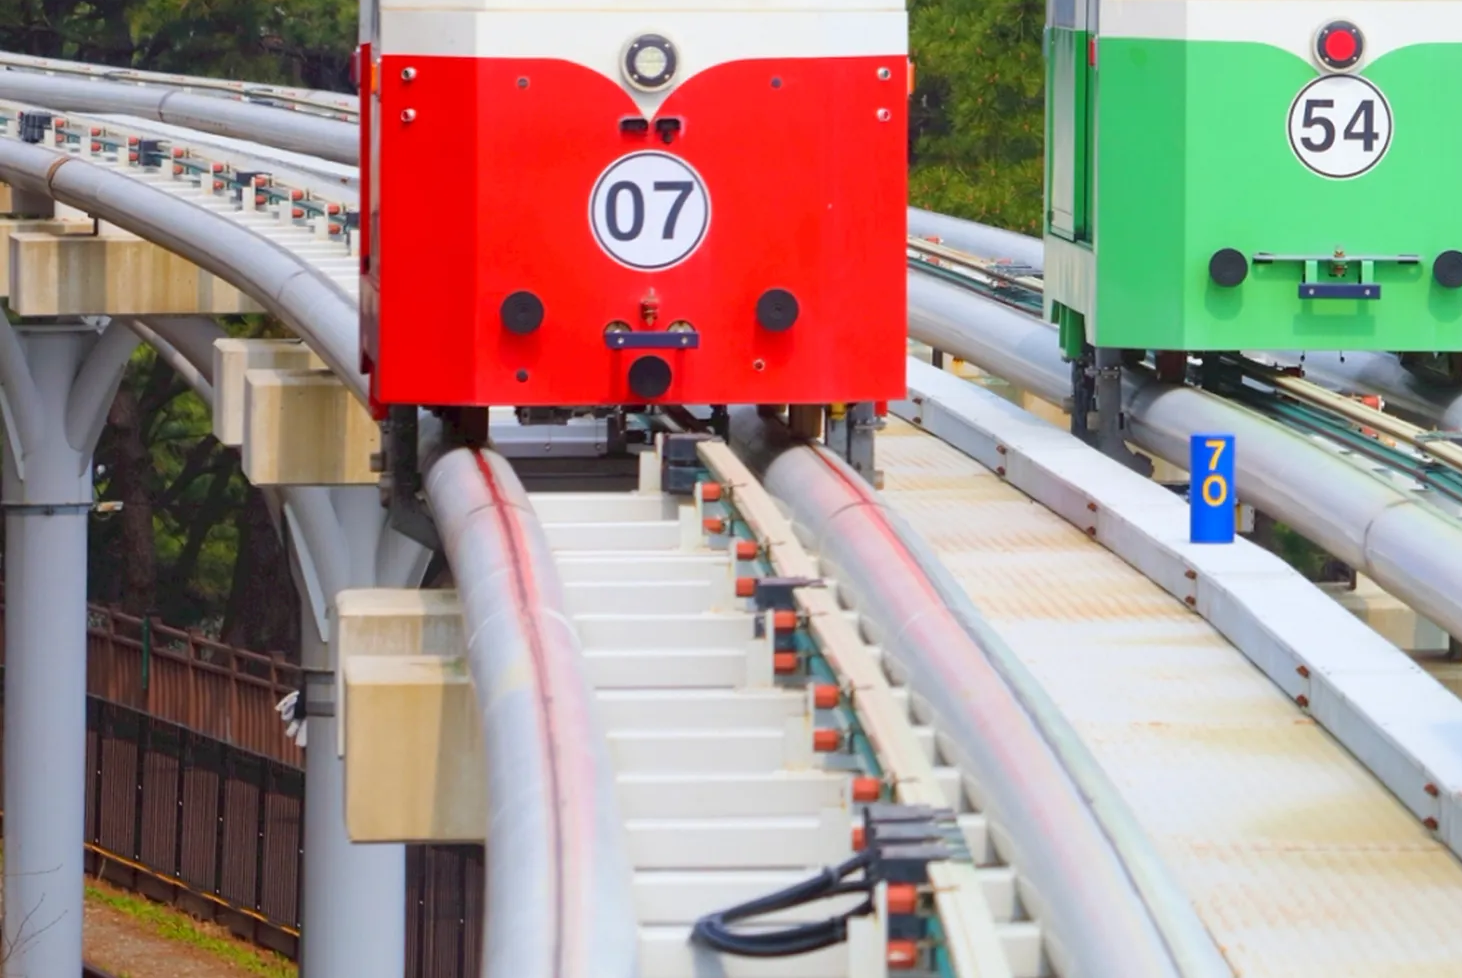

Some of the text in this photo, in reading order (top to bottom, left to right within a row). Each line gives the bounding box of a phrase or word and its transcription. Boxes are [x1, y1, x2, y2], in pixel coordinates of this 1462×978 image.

[1300, 99, 1379, 153] 54
[605, 180, 694, 241] 07
[1202, 439, 1227, 507] 70
